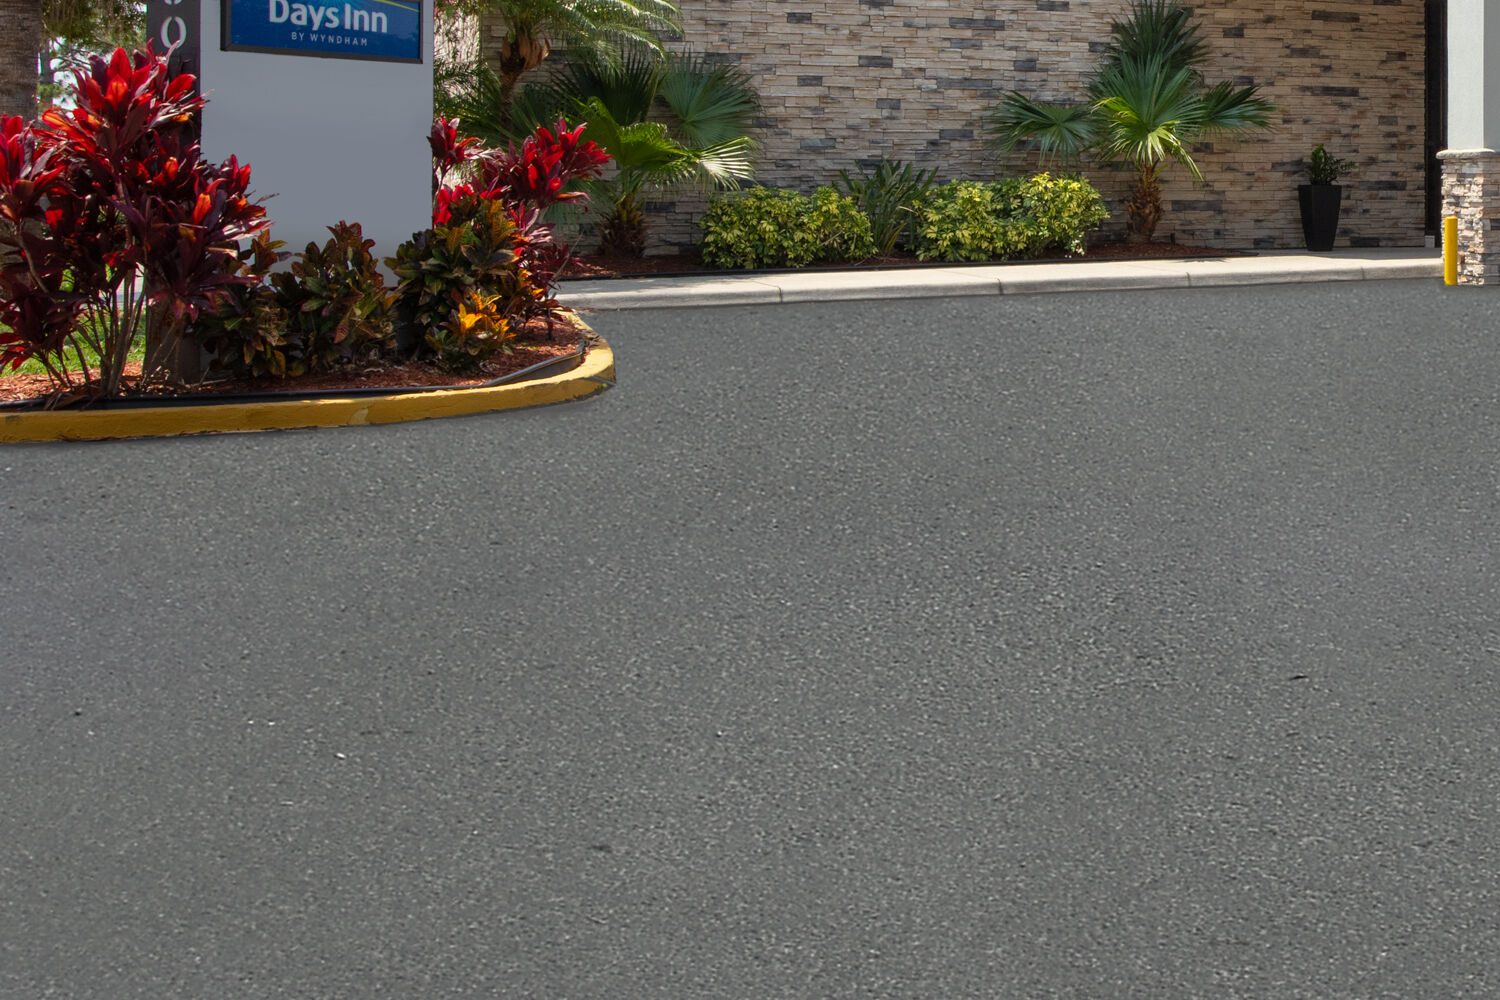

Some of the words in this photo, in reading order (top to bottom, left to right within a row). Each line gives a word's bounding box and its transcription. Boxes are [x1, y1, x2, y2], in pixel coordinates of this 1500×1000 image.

[344, 3, 388, 33] Inn
[291, 32, 305, 41] BY
[310, 33, 368, 47] WYNDHAM
